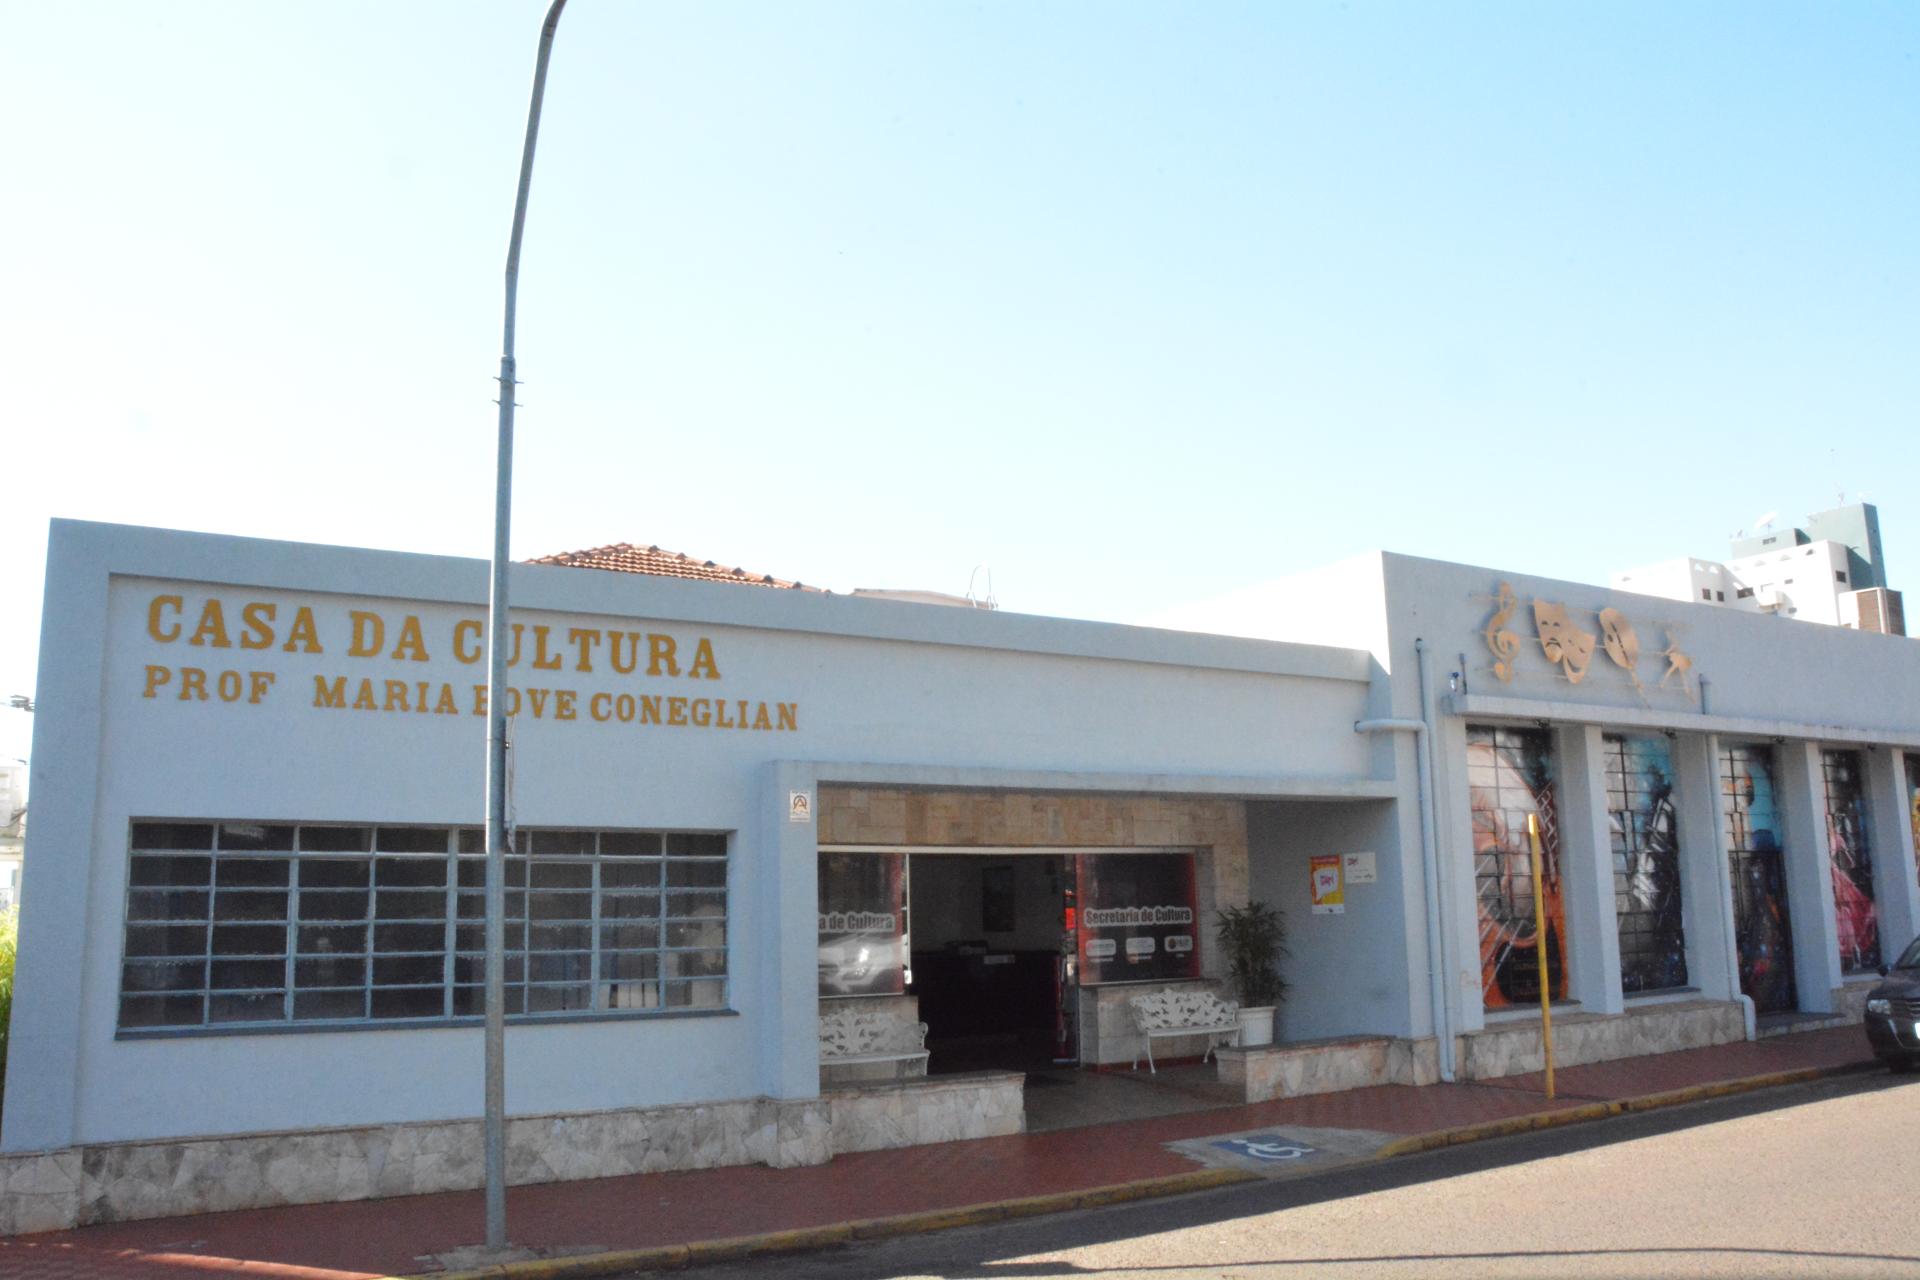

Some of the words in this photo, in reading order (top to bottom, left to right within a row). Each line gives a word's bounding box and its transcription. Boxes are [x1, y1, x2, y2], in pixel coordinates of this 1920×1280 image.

[147, 595, 323, 653] CASA
[348, 610, 430, 662] DA
[143, 665, 275, 704] PROF
[313, 675, 458, 714] MARIA
[590, 693, 798, 731] CONEGLIAN
[829, 914, 845, 929] de
[848, 914, 893, 930] Cultura
[1086, 909, 1139, 924] Secretaria
[1141, 908, 1154, 922] de
[1155, 907, 1190, 921] Cultura
